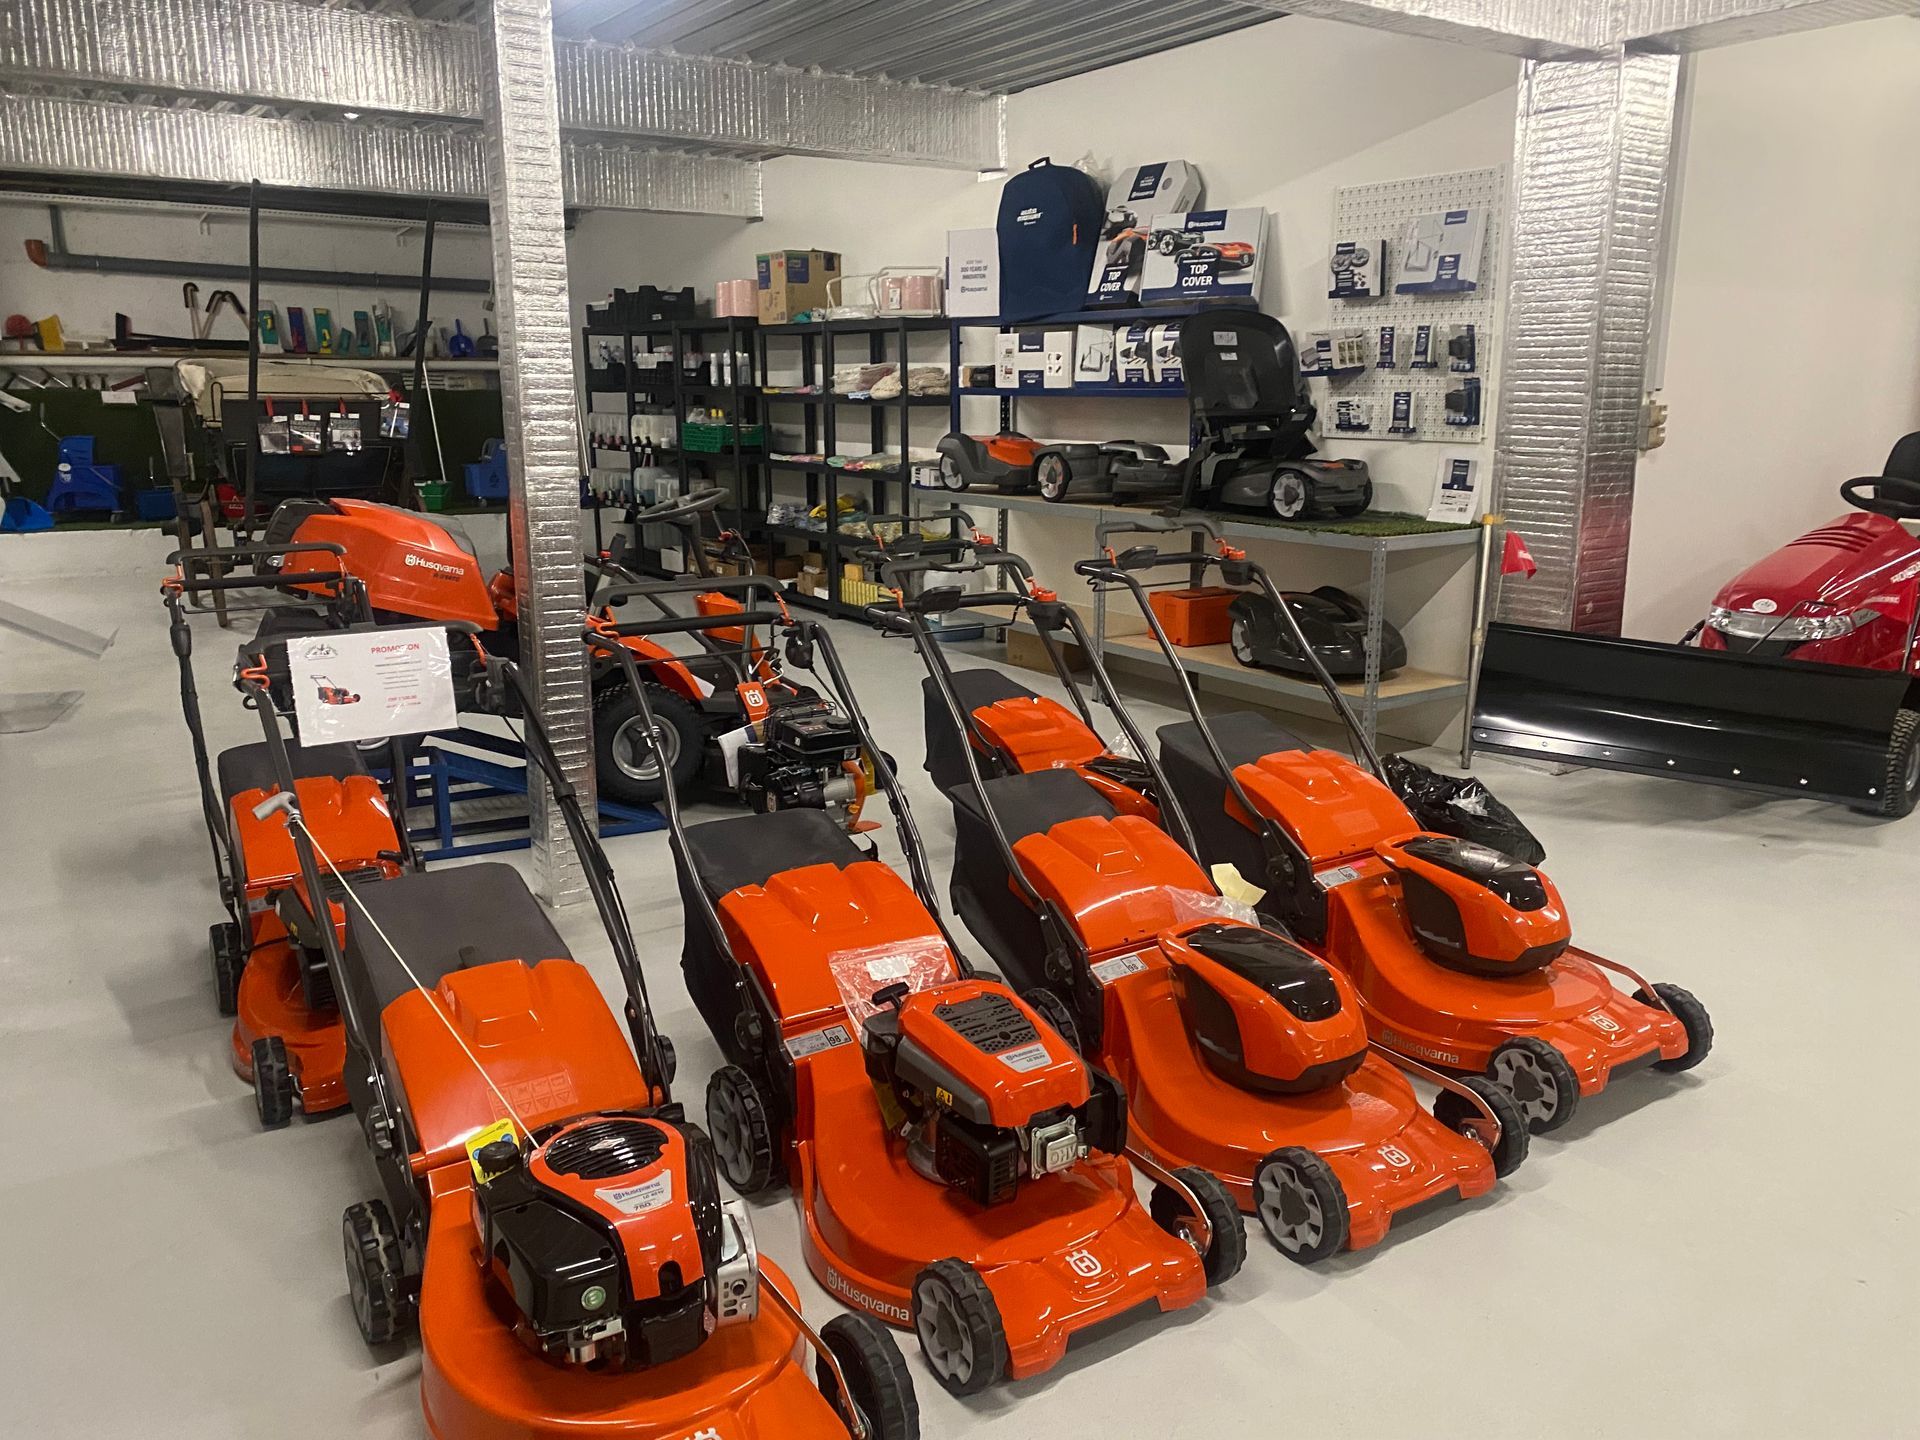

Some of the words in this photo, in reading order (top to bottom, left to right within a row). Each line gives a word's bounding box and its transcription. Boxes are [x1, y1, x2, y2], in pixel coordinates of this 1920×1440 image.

[1190, 265, 1208, 274] TOP
[1108, 272, 1121, 280] TOP
[1182, 276, 1213, 287] COVER
[1100, 282, 1120, 292] COVER
[415, 557, 465, 576] Husqvarna
[829, 1035, 842, 1045] 98
[1394, 1034, 1460, 1064] Husqvarna
[622, 1181, 660, 1197] Husqvarna
[838, 1276, 910, 1322] Husqvarna
